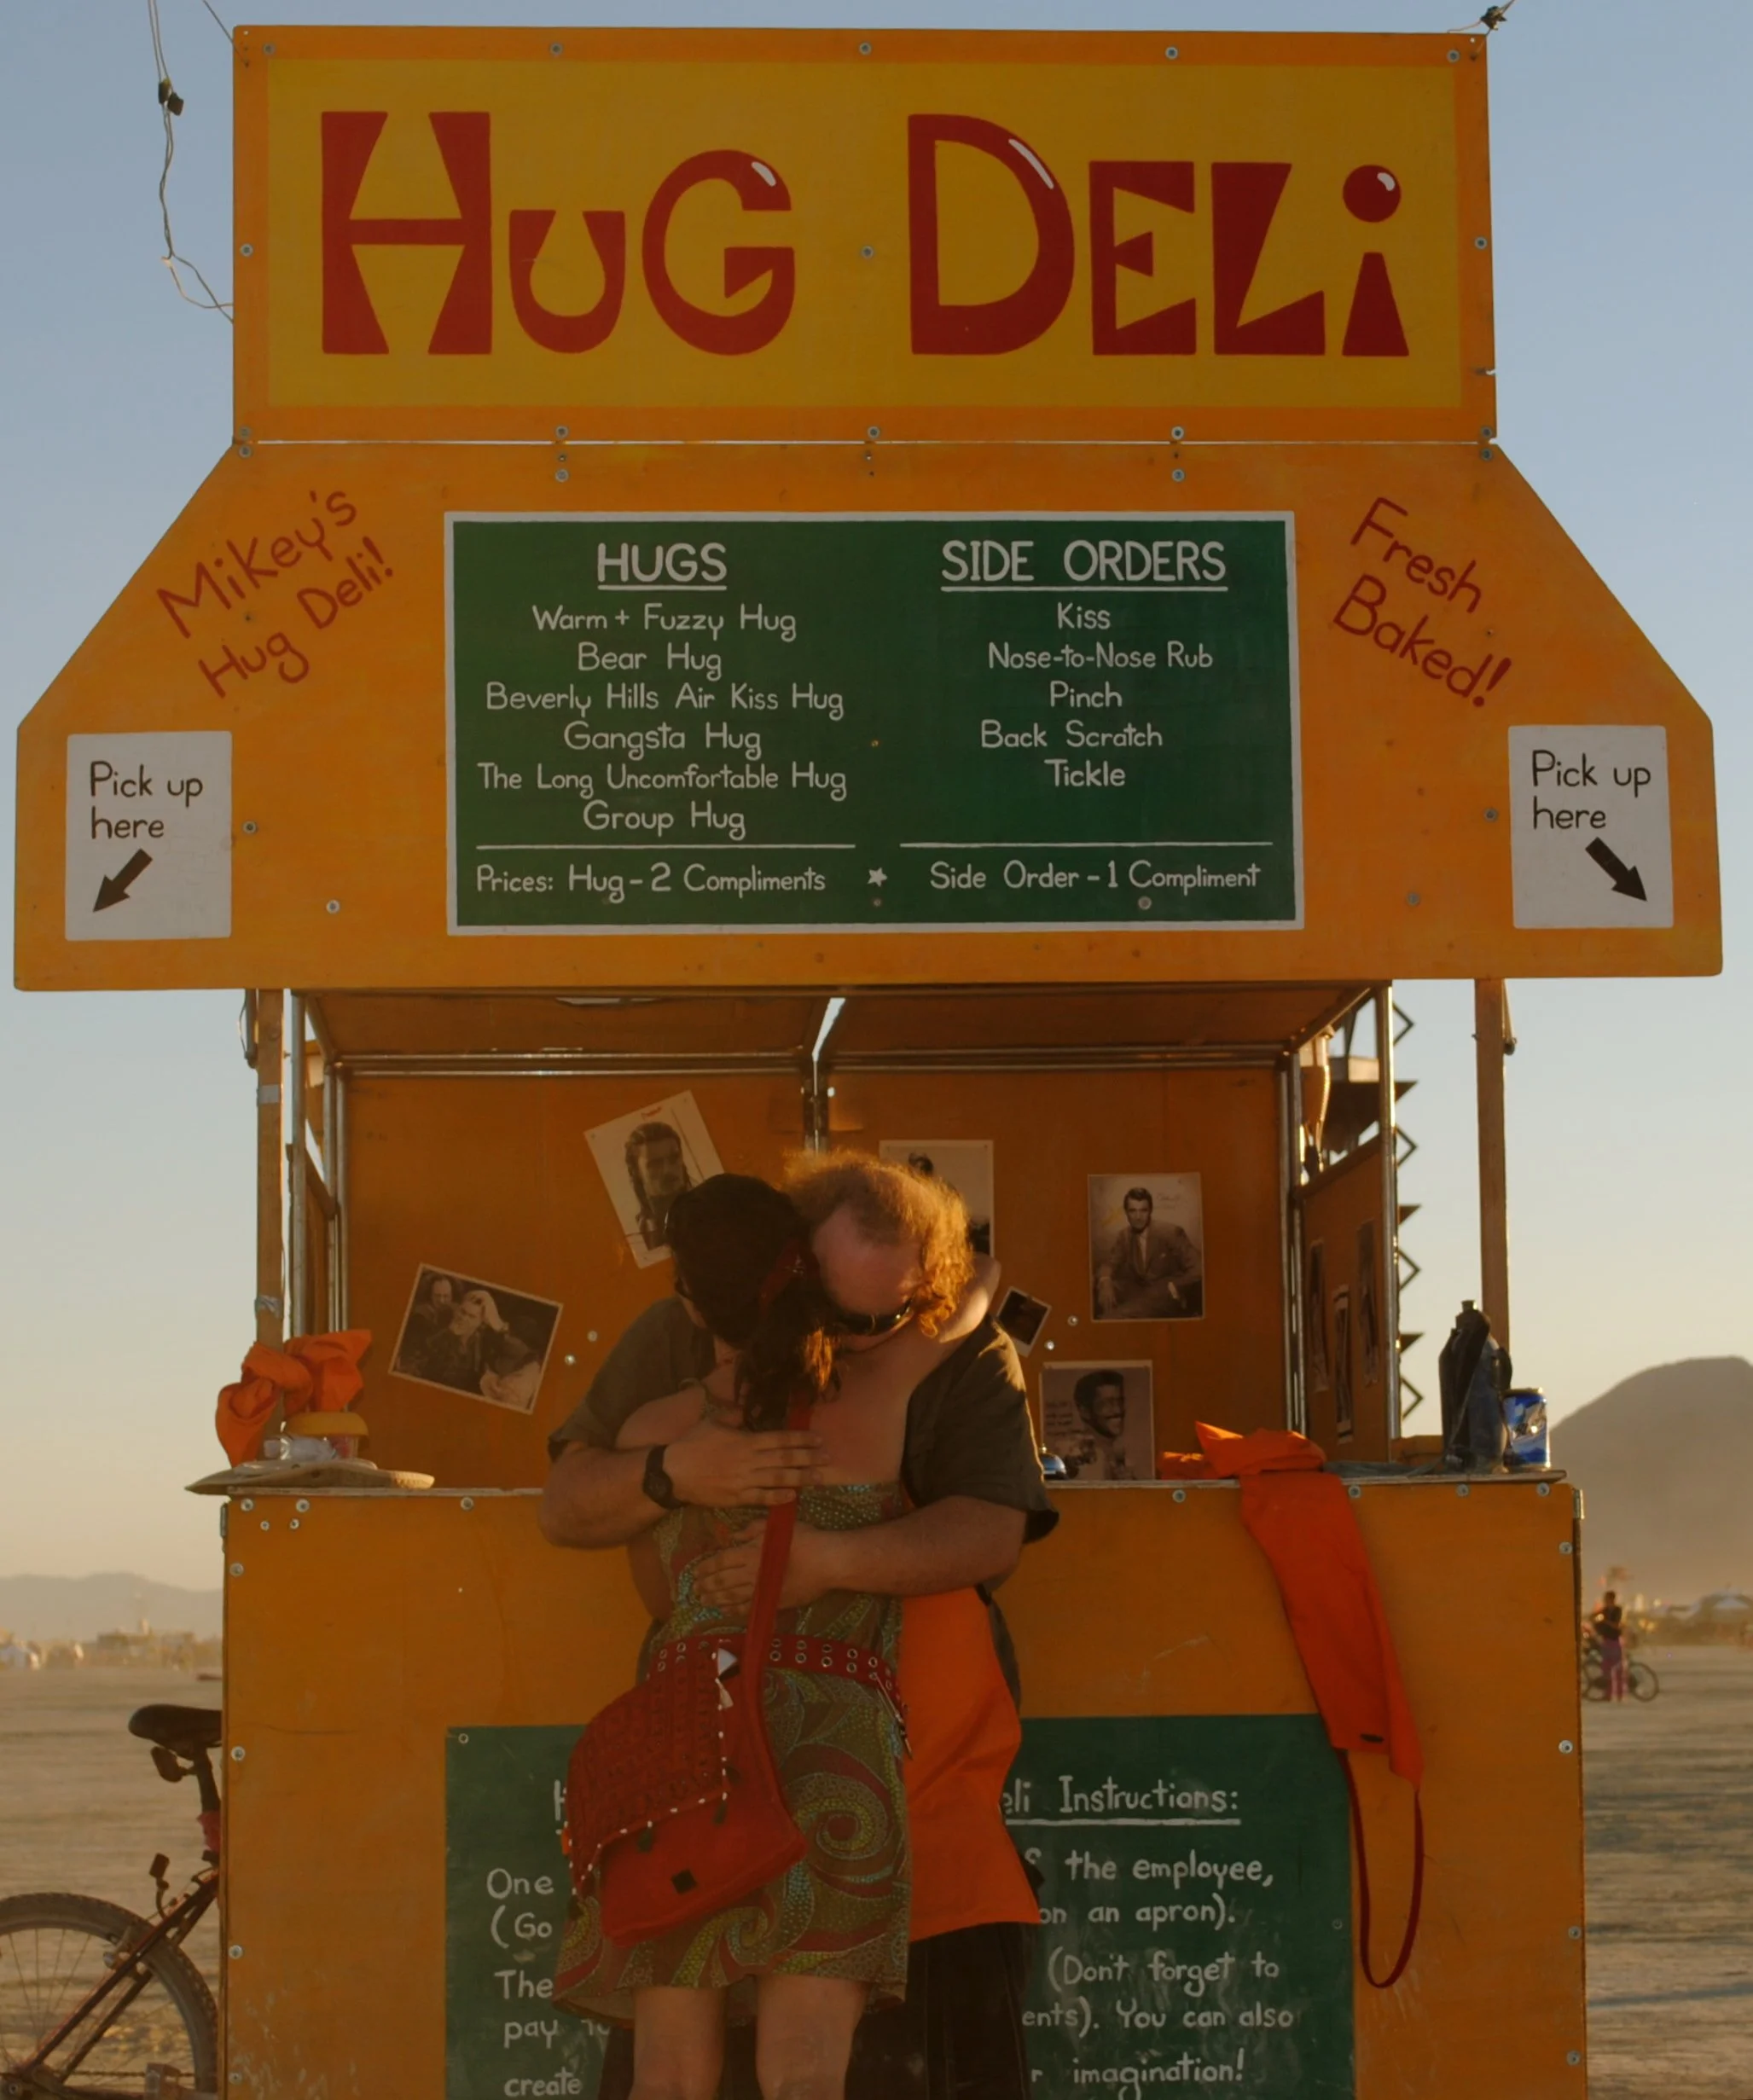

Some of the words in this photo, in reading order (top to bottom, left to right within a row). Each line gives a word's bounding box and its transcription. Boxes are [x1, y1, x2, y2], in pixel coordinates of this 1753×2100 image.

[597, 542, 727, 583] HUGS
[941, 539, 1035, 582] SIDE
[1063, 539, 1226, 582] ORDERS
[1350, 496, 1482, 614] Fresh
[198, 631, 311, 699] Hug
[296, 535, 393, 630] Deli!
[531, 605, 608, 630] Warm
[644, 602, 724, 641] Fuzzy
[740, 603, 797, 642] Hug
[1057, 601, 1111, 629] Kiss
[989, 641, 1156, 669] Nose-to-Nose
[1167, 640, 1213, 668] Rub
[1332, 572, 1512, 708] Baked!
[578, 641, 647, 671] Bear
[667, 641, 722, 682] Hug
[486, 681, 592, 718] Beverly
[607, 682, 659, 710] Hills
[675, 682, 715, 709] Air
[731, 682, 779, 711] Kiss
[792, 682, 845, 722] Hug
[1050, 680, 1123, 708] Pinch
[564, 720, 686, 761] Gangsta
[705, 722, 762, 761] Hug
[981, 719, 1048, 749] Back
[1065, 719, 1163, 747] Scratch
[90, 760, 153, 798] Pick
[166, 777, 204, 808] up
[477, 762, 522, 790] The
[537, 763, 595, 800] Long
[607, 763, 779, 790] Uncomfortable
[792, 761, 847, 802] Hug
[1043, 758, 1126, 787] Tickle
[1532, 749, 1598, 787] Pick
[1613, 767, 1651, 798] up
[91, 805, 165, 840] here
[583, 799, 674, 838] Group
[691, 800, 746, 841] Hug
[1533, 795, 1606, 830] here
[477, 863, 554, 892] Prices:
[683, 862, 826, 899] Compliments
[930, 861, 987, 890] Side
[1129, 859, 1262, 896] Compliment
[1059, 1775, 1238, 1813] Instructions:
[486, 1868, 554, 1900] One
[1064, 1849, 1117, 1881] the
[1132, 1848, 1274, 1889] employee,
[1088, 1906, 1120, 1923] an
[1135, 1892, 1235, 1932] apron).
[494, 1969, 554, 1999] The
[1147, 1950, 1236, 1998] forget
[1251, 1951, 1280, 1978] to
[1116, 1998, 1166, 2028] You
[1182, 2010, 1226, 2027] can
[1239, 2001, 1294, 2027] also
[503, 2019, 558, 2049] pay
[503, 2067, 581, 2097] create
[1072, 2047, 1245, 2100] imagination!
